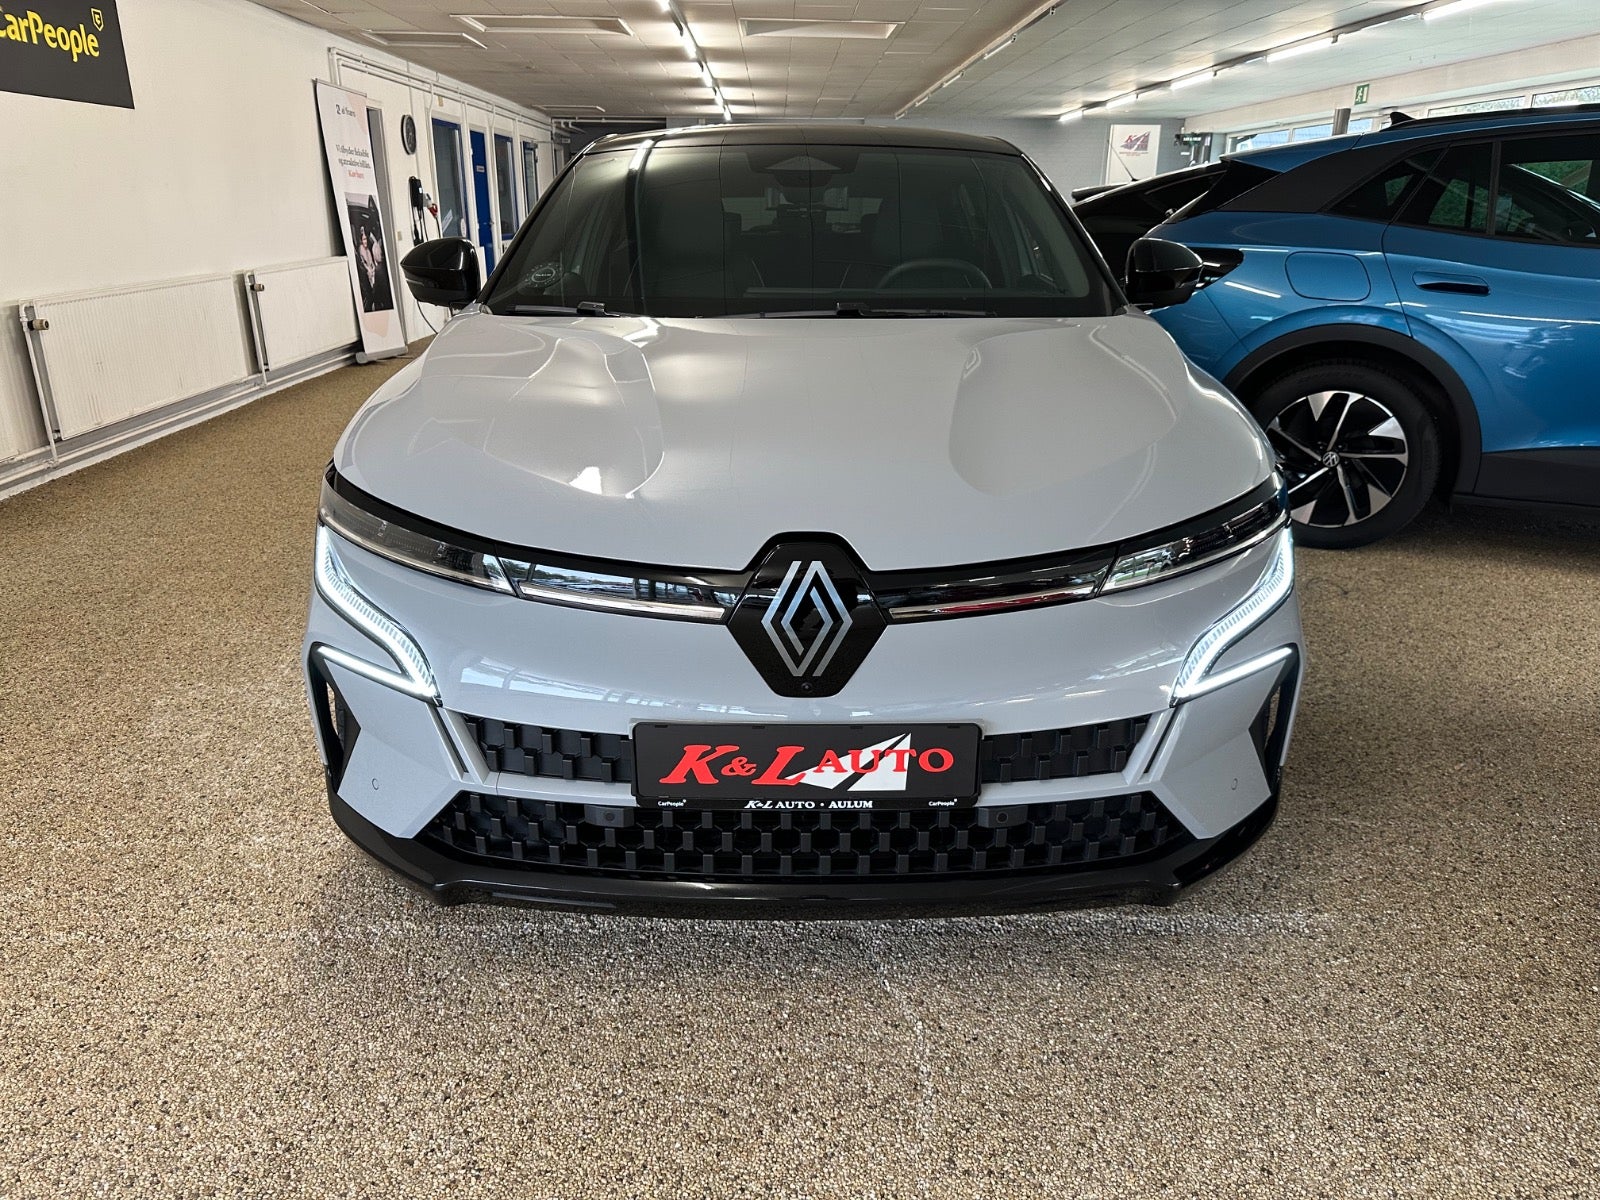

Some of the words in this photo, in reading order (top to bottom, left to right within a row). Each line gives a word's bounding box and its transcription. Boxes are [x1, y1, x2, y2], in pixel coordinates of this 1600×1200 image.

[812, 748, 954, 774] AUTO
[657, 800, 684, 808] CarPeople
[775, 800, 816, 809] AUTO
[828, 800, 873, 809] AULUM
